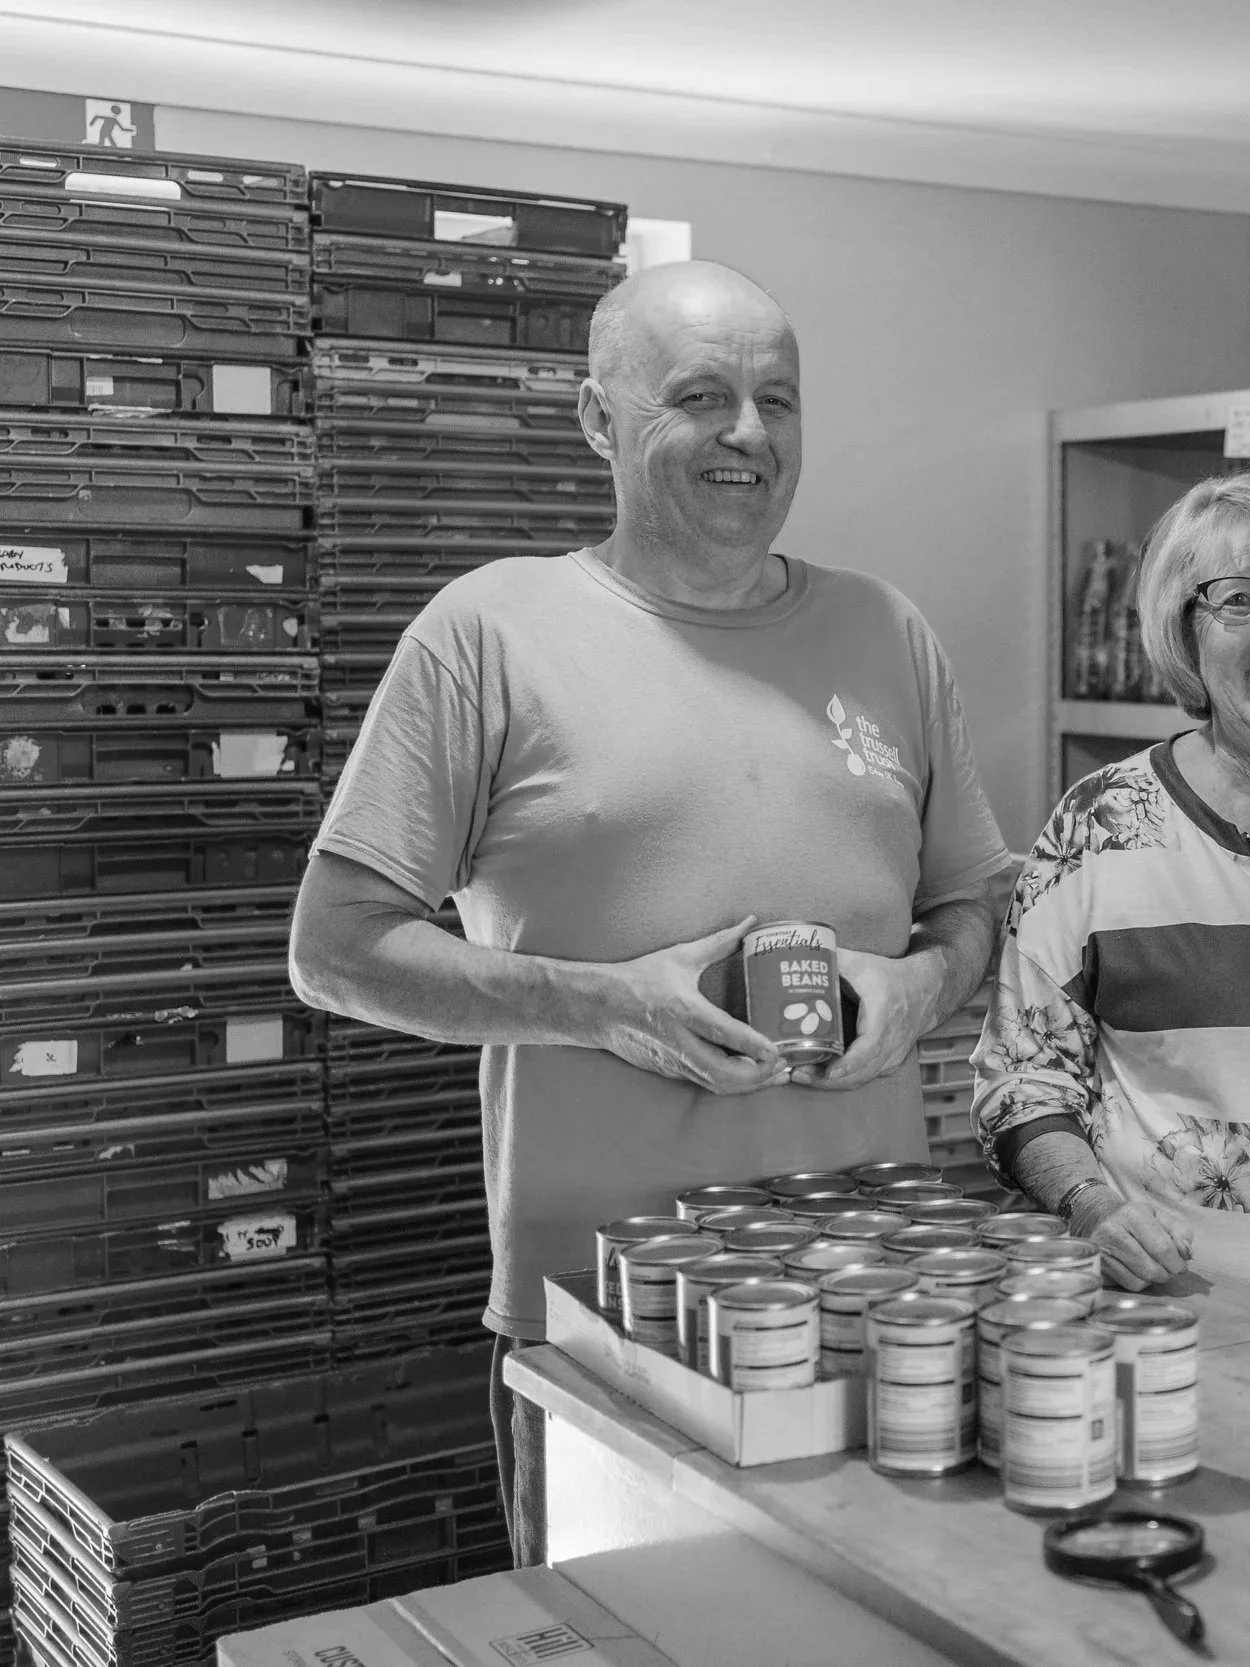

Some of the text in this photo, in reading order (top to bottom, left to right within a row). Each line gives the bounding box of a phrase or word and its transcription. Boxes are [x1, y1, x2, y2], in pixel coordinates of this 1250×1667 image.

[856, 715, 880, 738] the
[754, 929, 823, 957] Essentials
[780, 960, 828, 974] BAKED
[781, 973, 829, 987] BEANS
[517, 1626, 584, 1659] Hill
